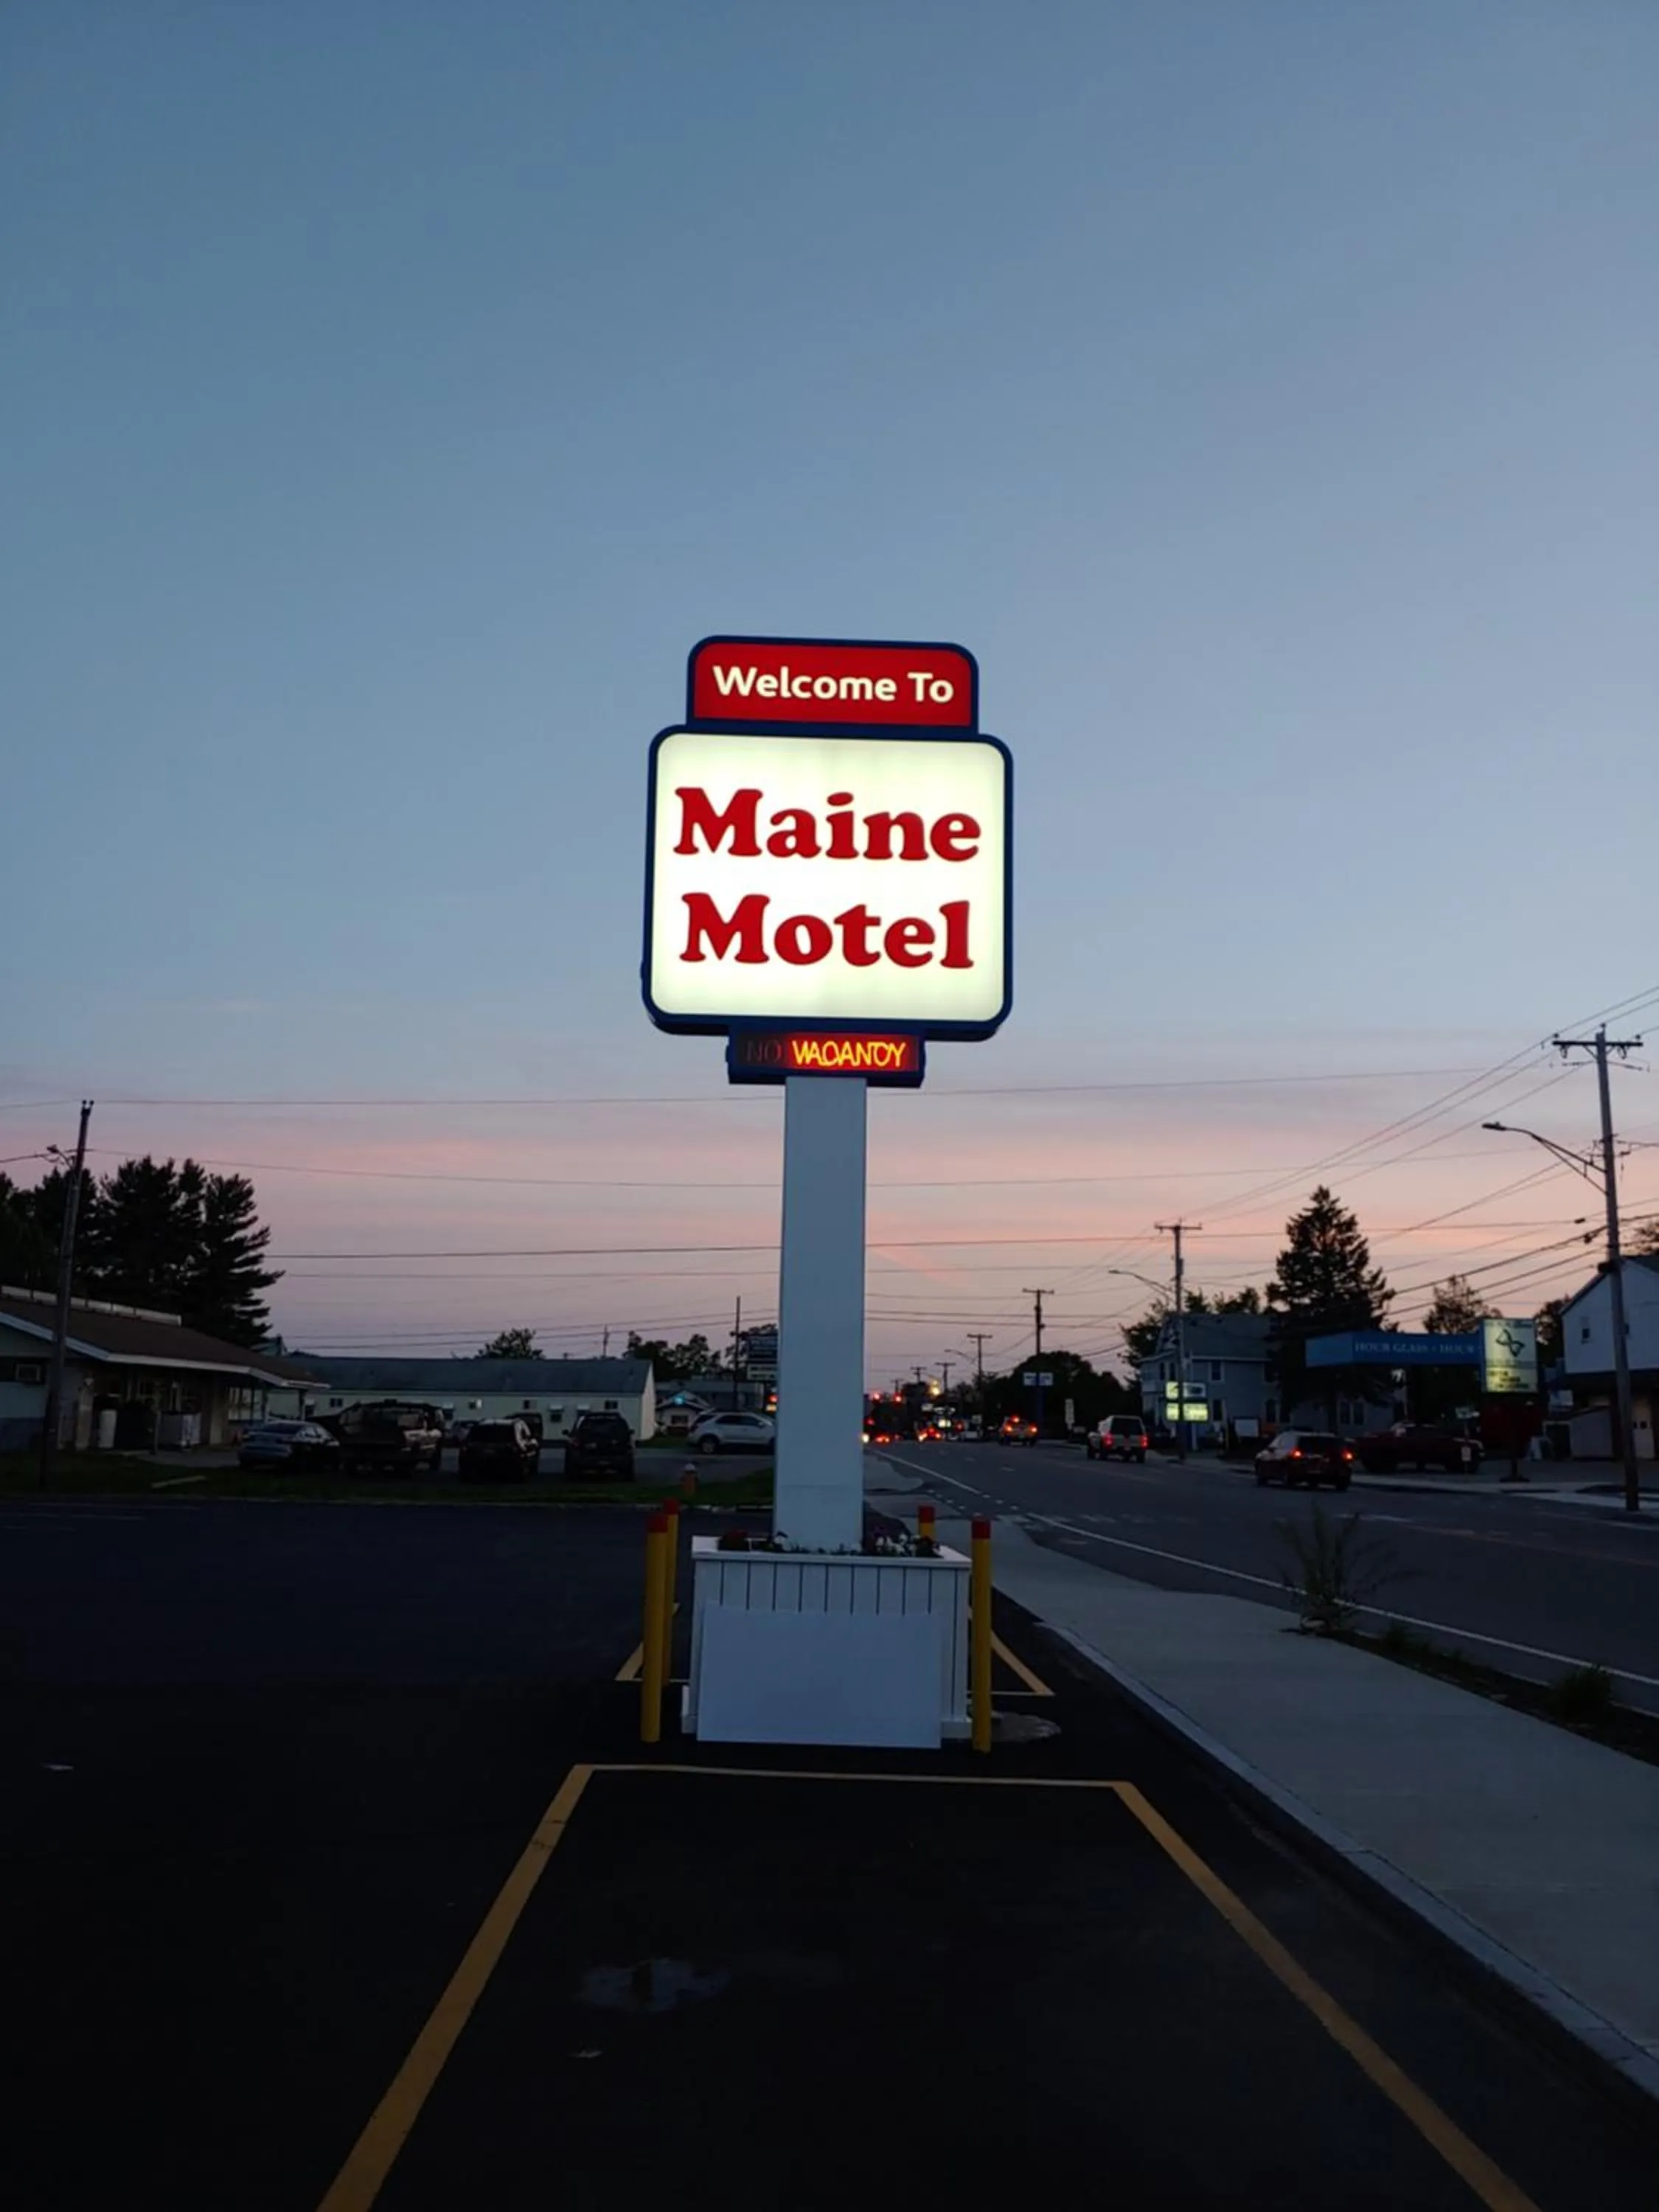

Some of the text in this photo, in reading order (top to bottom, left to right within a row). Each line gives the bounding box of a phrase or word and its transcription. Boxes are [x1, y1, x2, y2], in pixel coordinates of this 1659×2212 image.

[713, 666, 954, 703] Welcome To
[674, 787, 981, 862] Maine
[680, 892, 973, 969] Motel
[746, 1039, 906, 1068] NO VACANCY
